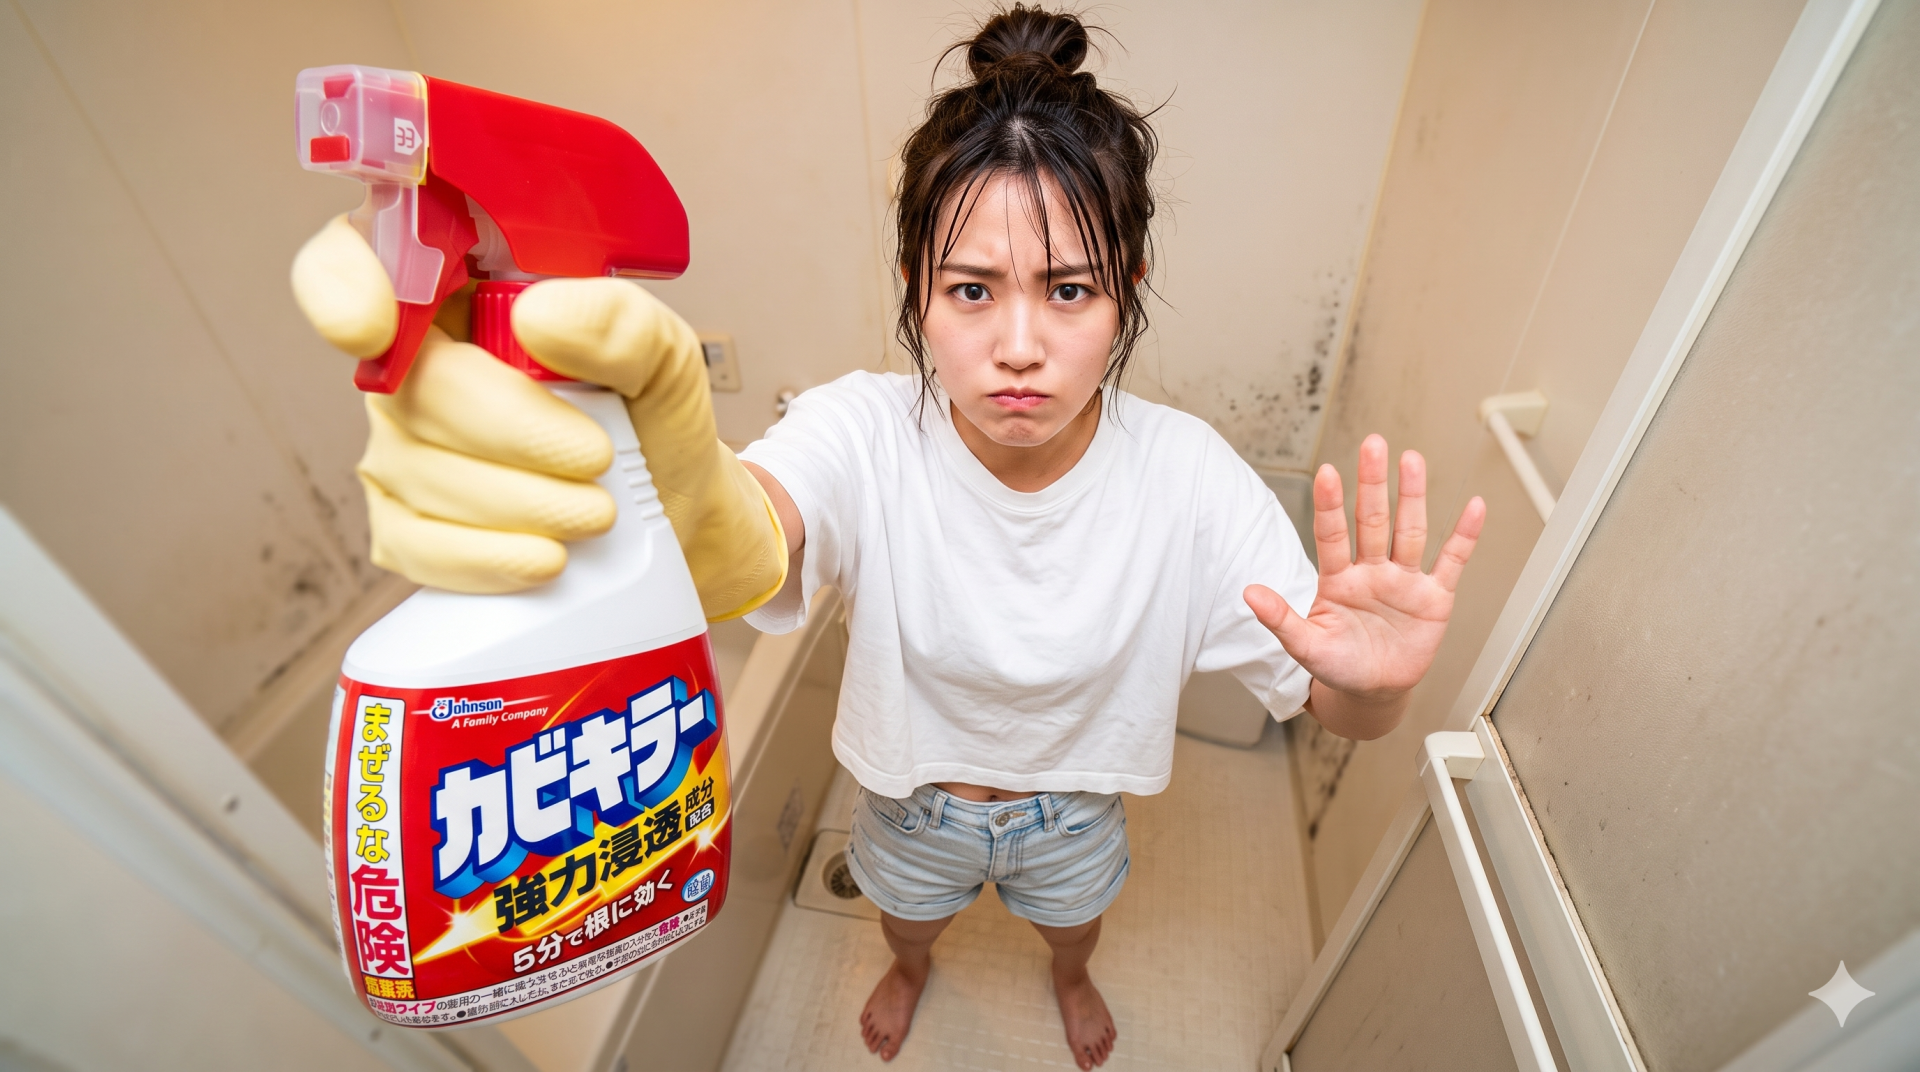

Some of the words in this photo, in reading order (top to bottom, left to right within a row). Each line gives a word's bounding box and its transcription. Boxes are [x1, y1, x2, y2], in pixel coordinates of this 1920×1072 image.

[432, 699, 503, 719] Johnson
[451, 719, 460, 729] A
[463, 714, 499, 729] Family
[501, 706, 549, 723] Company
[434, 679, 710, 886] カビキラー
[685, 776, 715, 813] 成分
[689, 803, 713, 829] 配合
[351, 703, 409, 977] まぜるな危険
[493, 799, 684, 933] 強力浸透
[512, 868, 675, 975] 5分で根に効く
